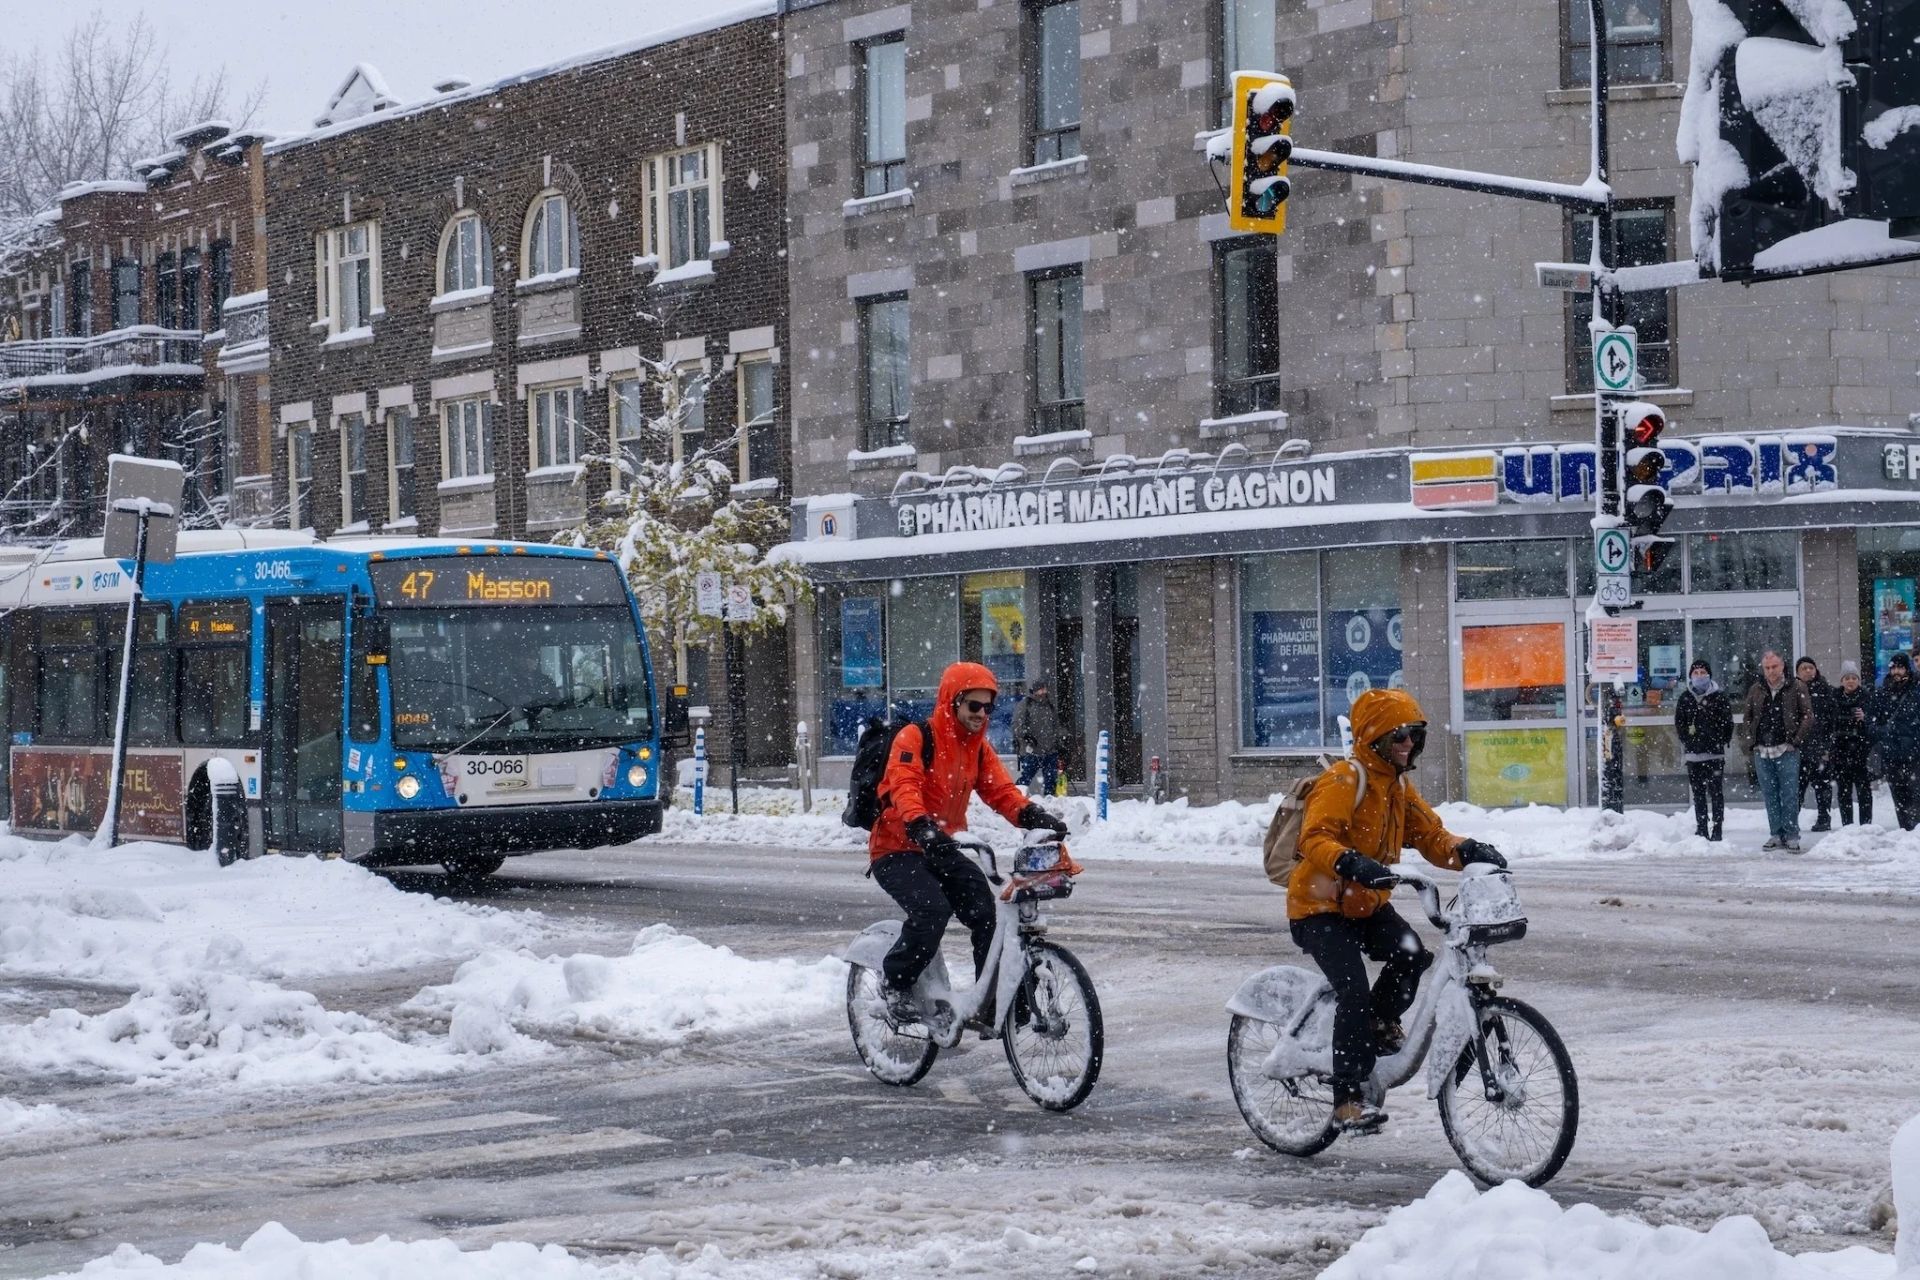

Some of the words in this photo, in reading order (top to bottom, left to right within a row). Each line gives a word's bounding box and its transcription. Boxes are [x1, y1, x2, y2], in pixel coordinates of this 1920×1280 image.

[1543, 275, 1574, 288] Laurier
[1502, 435, 1836, 504] UNPRIX
[915, 490, 1065, 535] PHARMACIE
[1069, 476, 1197, 523] MARIANE
[1203, 467, 1336, 511] GAGNON
[254, 560, 291, 580] 30-066
[101, 571, 121, 588] STM
[401, 571, 434, 599] 47
[467, 571, 551, 599] Masson
[190, 620, 200, 632] 47
[1280, 645, 1291, 656] DE
[466, 759, 524, 775] 30-066
[106, 769, 152, 792] HTEL
